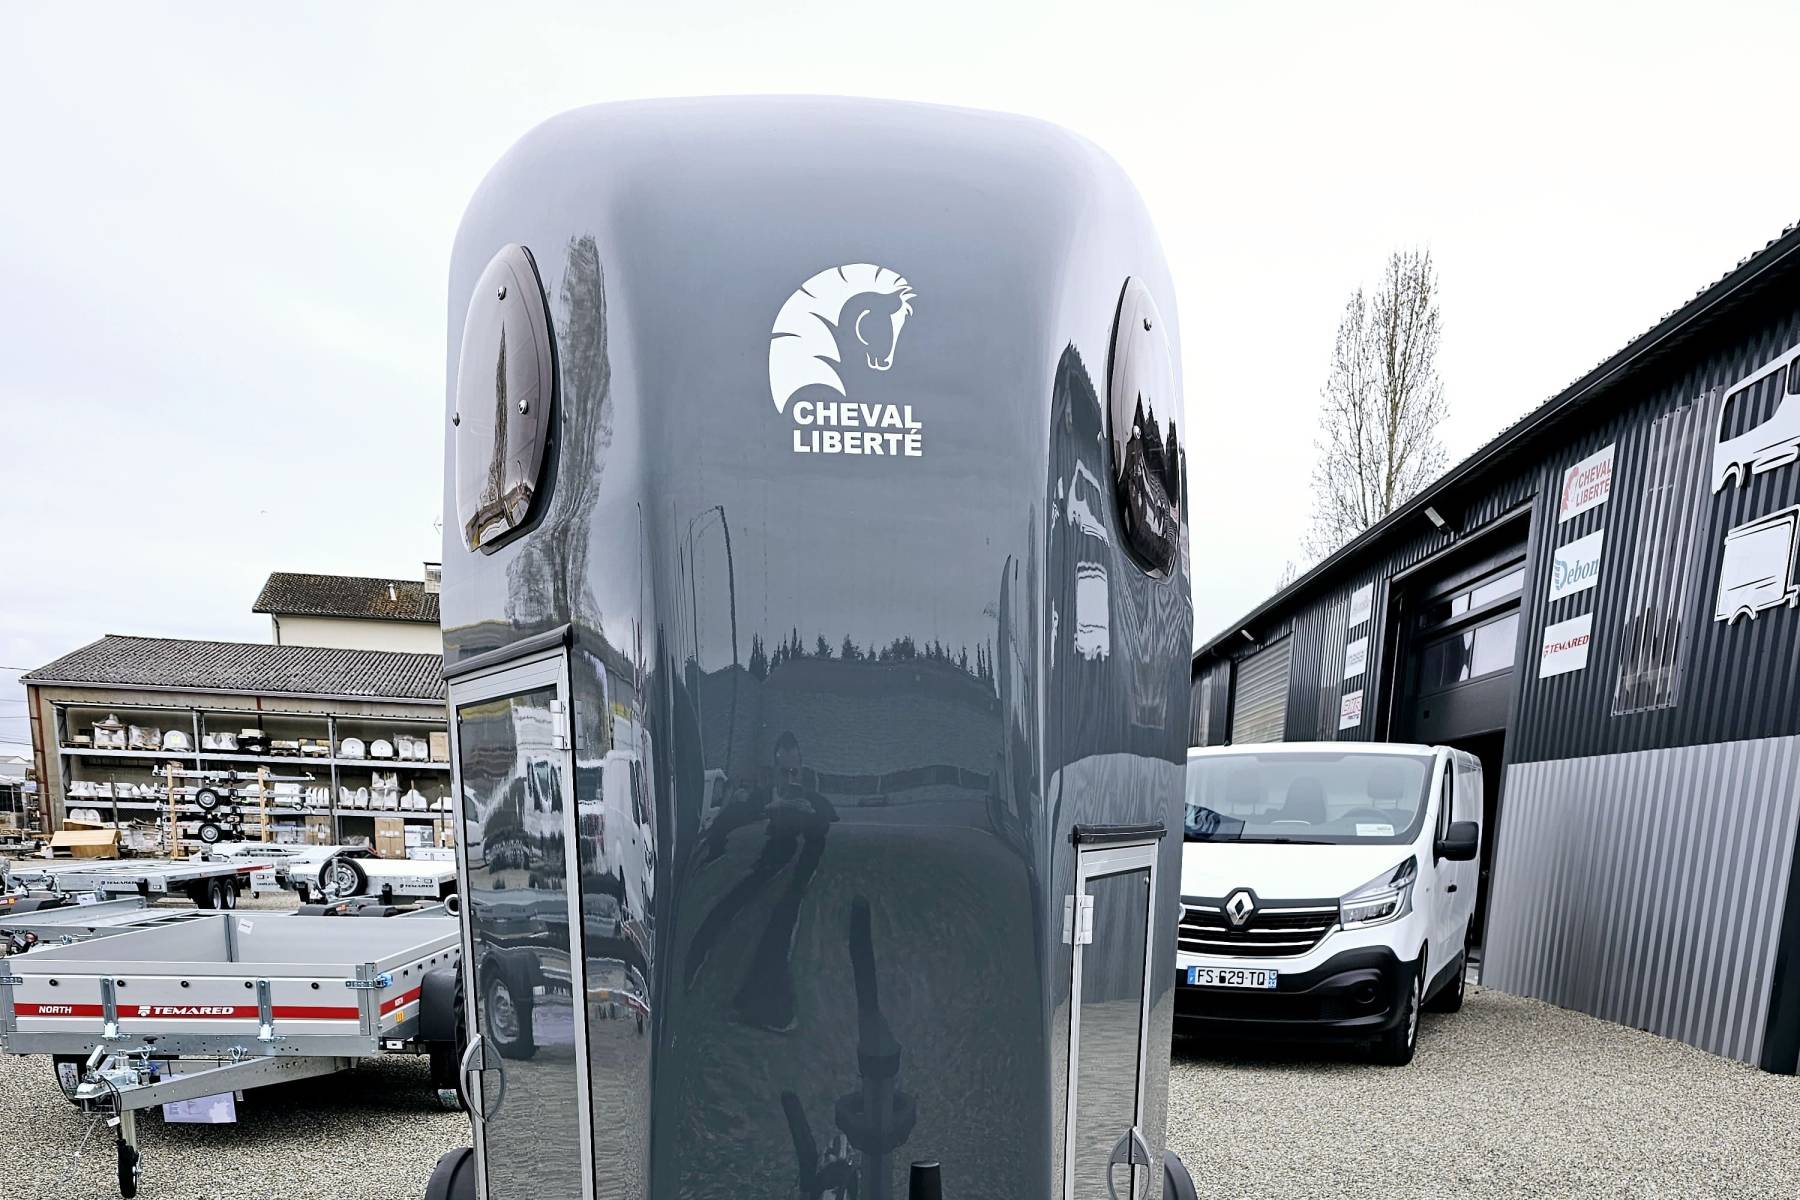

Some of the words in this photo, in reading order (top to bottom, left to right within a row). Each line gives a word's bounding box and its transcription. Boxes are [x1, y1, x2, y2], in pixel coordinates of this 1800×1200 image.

[793, 401, 922, 429] CHEVAL
[793, 429, 922, 457] LIBERTÉ
[1578, 458, 1612, 488] CHEVAL
[1554, 557, 1599, 591] Debon
[1549, 635, 1589, 654] TEMARED
[38, 1005, 72, 1014] NORTH
[153, 1006, 235, 1015] TEMARED
